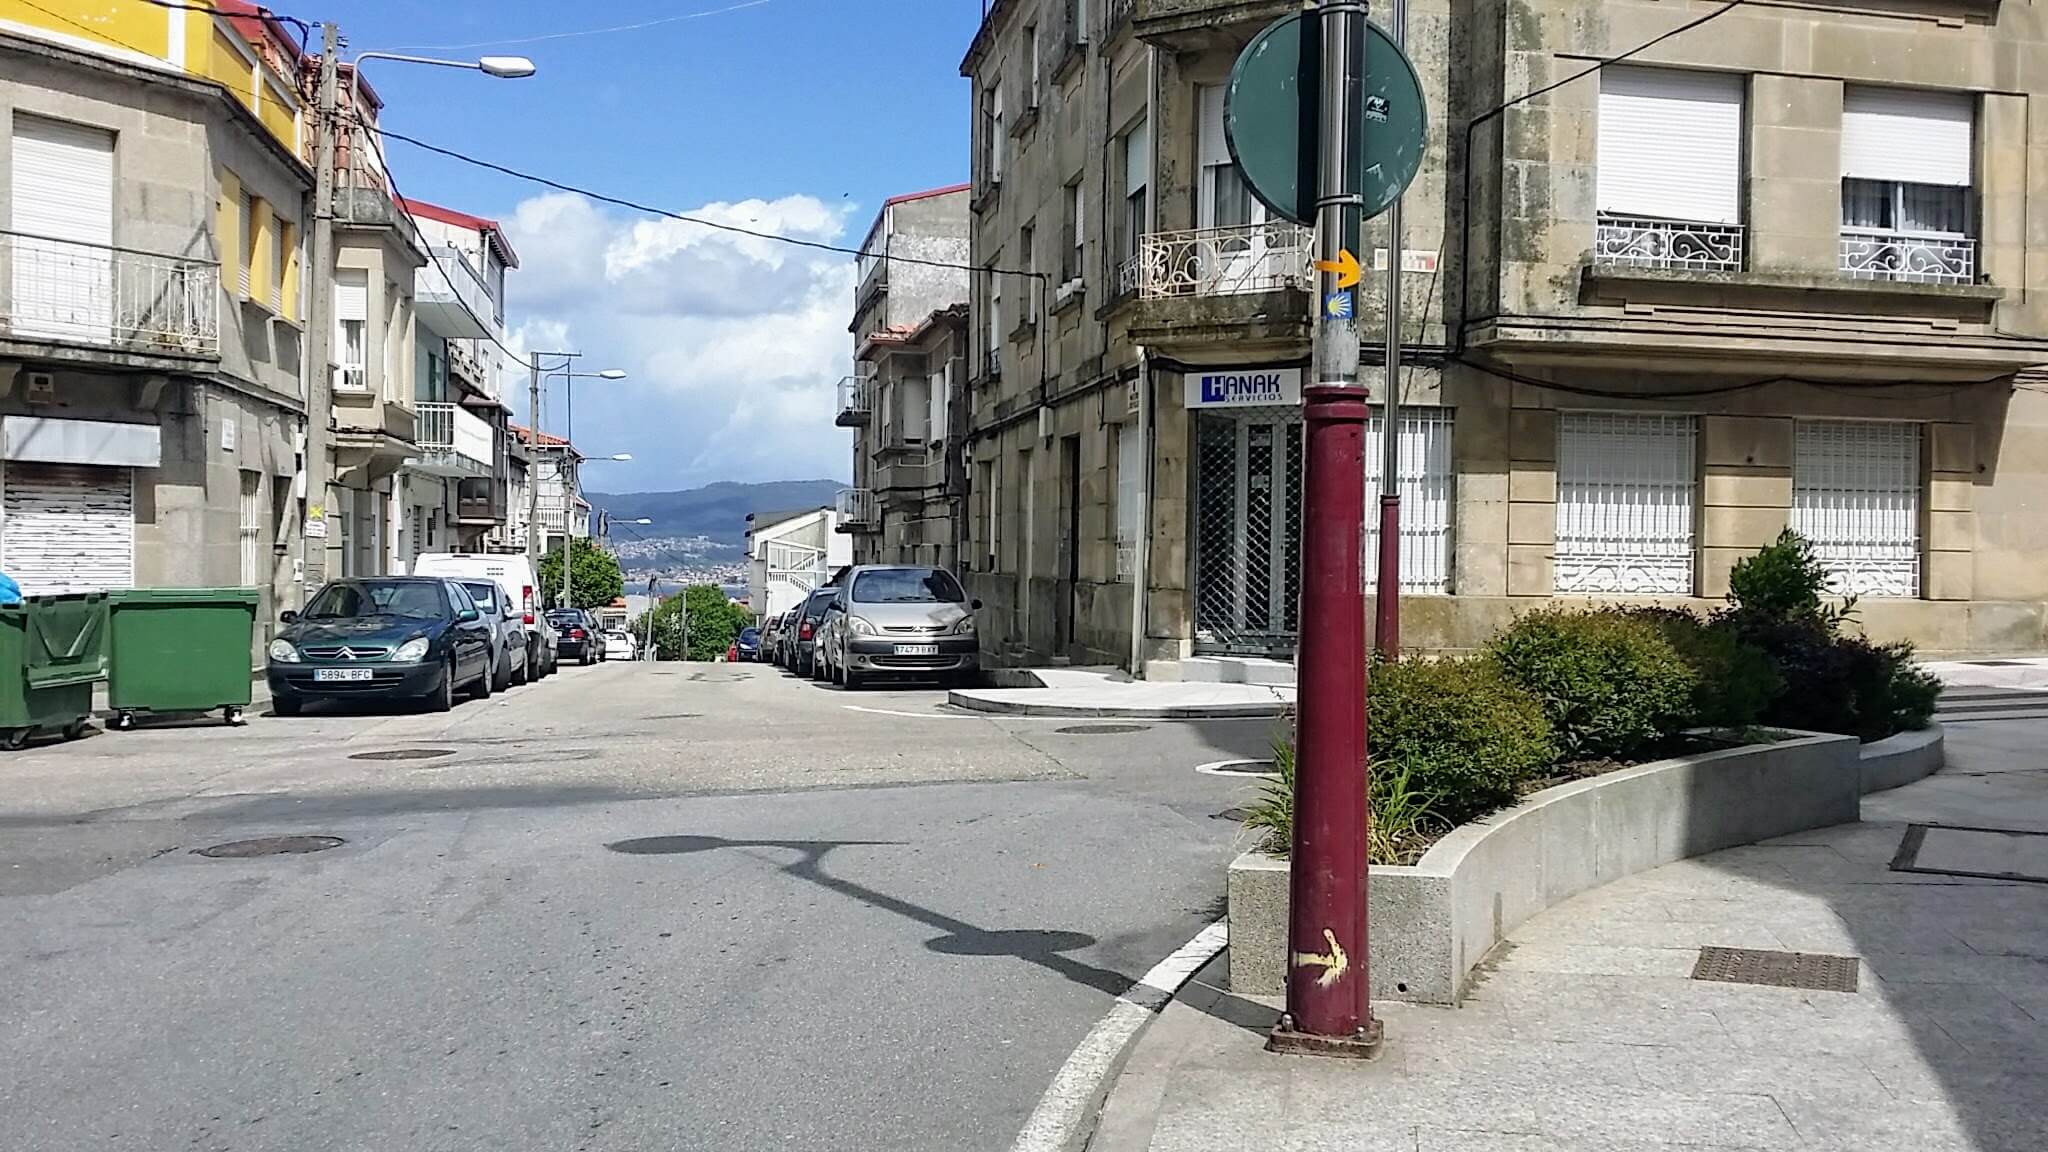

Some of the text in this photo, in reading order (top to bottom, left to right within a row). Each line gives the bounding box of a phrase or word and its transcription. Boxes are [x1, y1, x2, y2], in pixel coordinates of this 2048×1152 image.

[1202, 374, 1281, 402] HANAK
[1225, 393, 1283, 402] SERVICIOS
[321, 670, 370, 680] 5894 BFC
